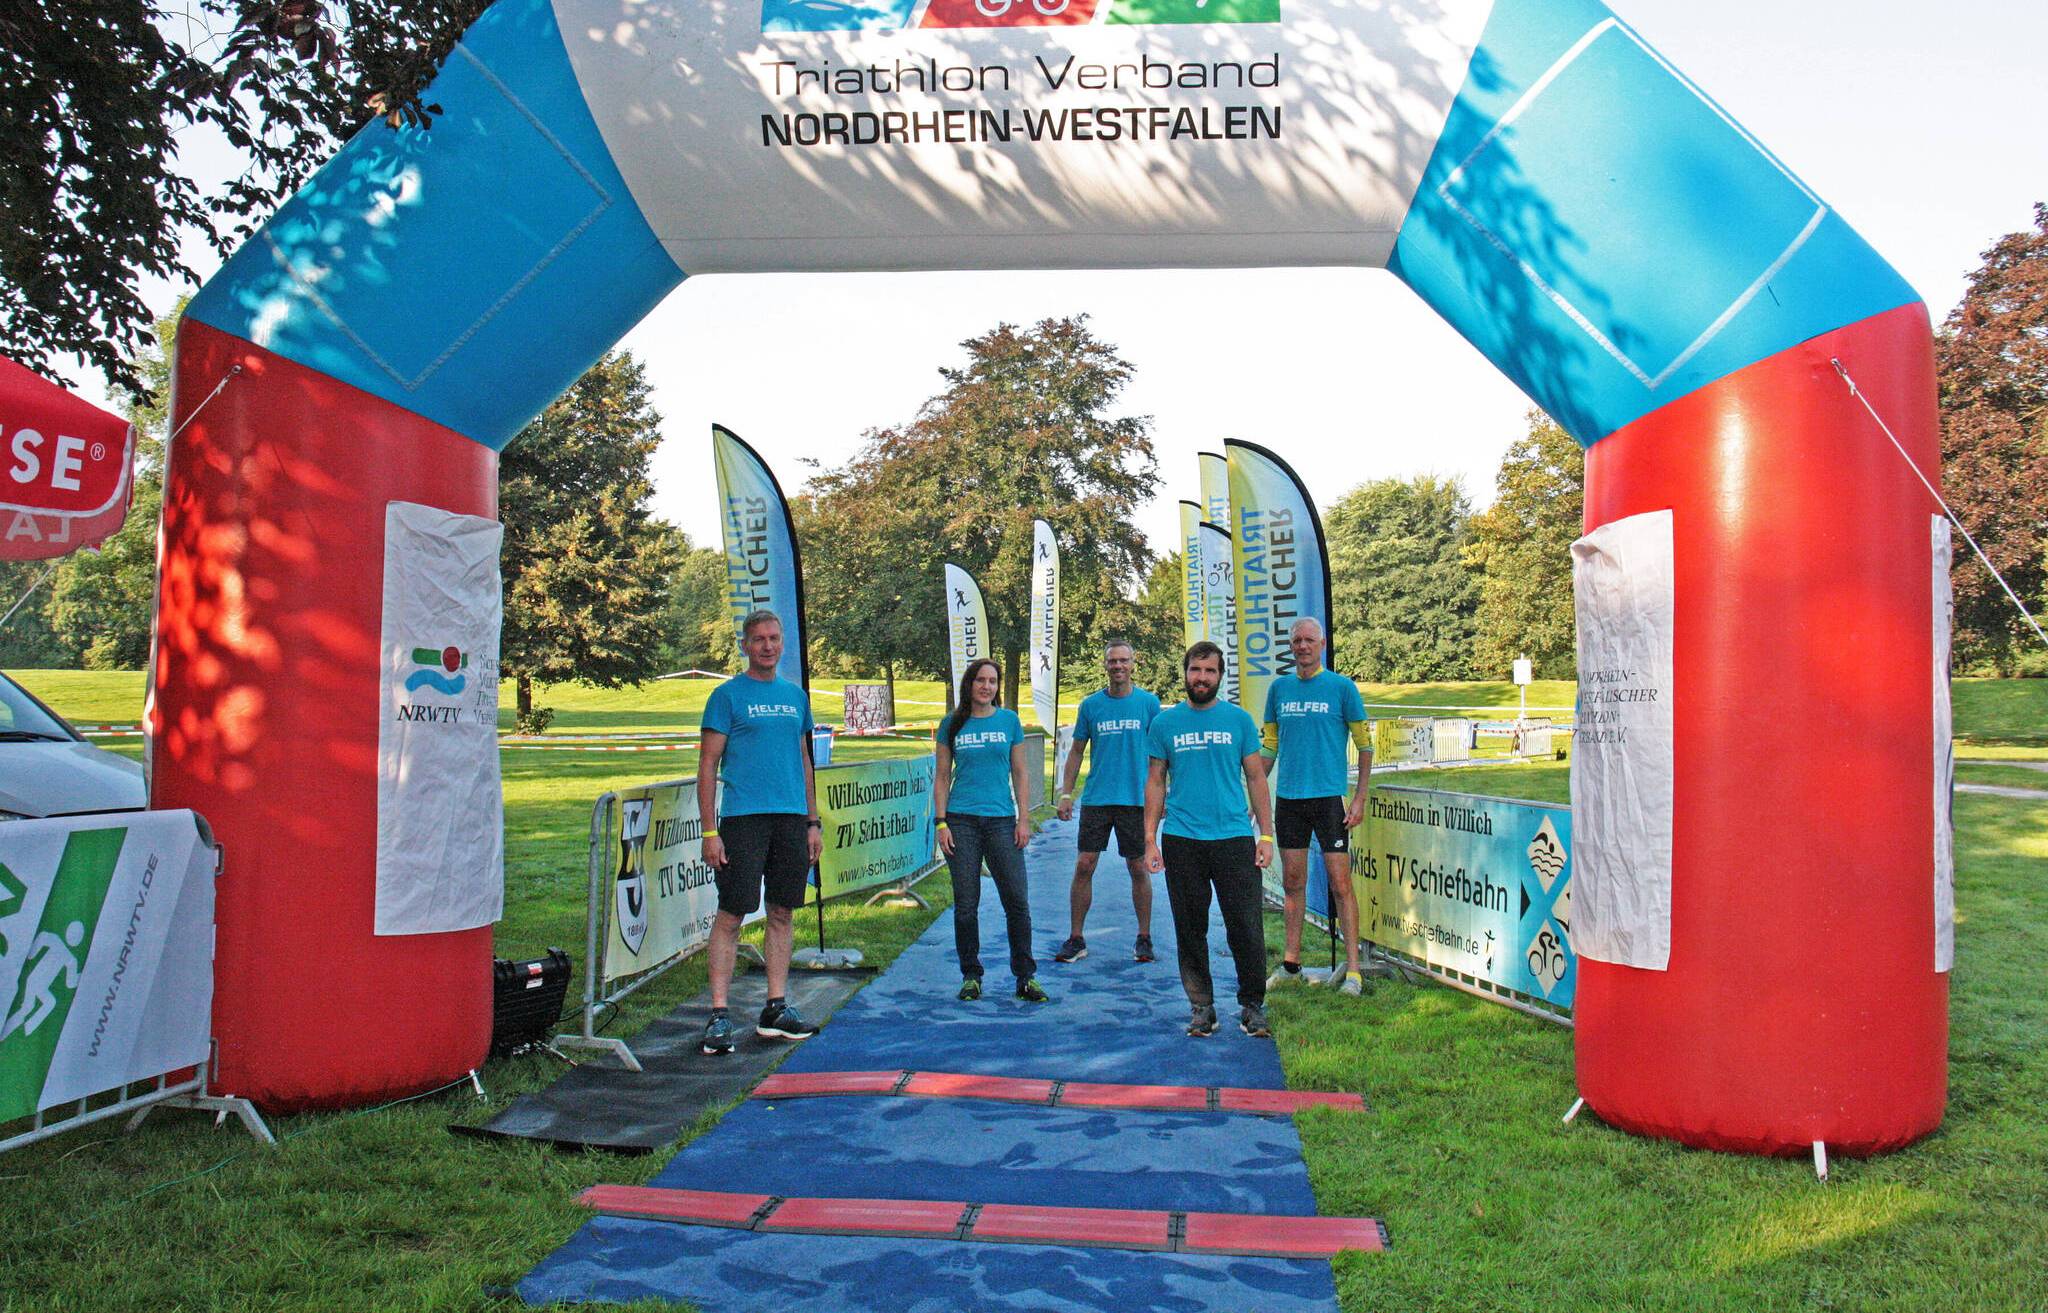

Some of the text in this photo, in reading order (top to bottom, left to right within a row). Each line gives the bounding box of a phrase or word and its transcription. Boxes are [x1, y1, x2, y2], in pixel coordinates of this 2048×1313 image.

[760, 53, 1279, 95] Triathlon Verband
[760, 106, 1280, 146] NORDRHEIN-WESTFALEN
[398, 705, 462, 724] NRWTV
[747, 704, 797, 714] HELFER
[1281, 701, 1329, 713] HELFER
[955, 731, 1007, 746] HELFER
[1096, 719, 1141, 732] HELFER
[1173, 731, 1232, 747] HELFER
[827, 780, 907, 810] Willkommen
[1370, 797, 1493, 836] Triathlon in Willich
[836, 822, 855, 850] TV
[1353, 847, 1378, 881] Kids
[658, 865, 674, 899] TV
[1386, 853, 1508, 914] TV Schiefbahn
[88, 852, 159, 1058] WWW.NRWTV.DE
